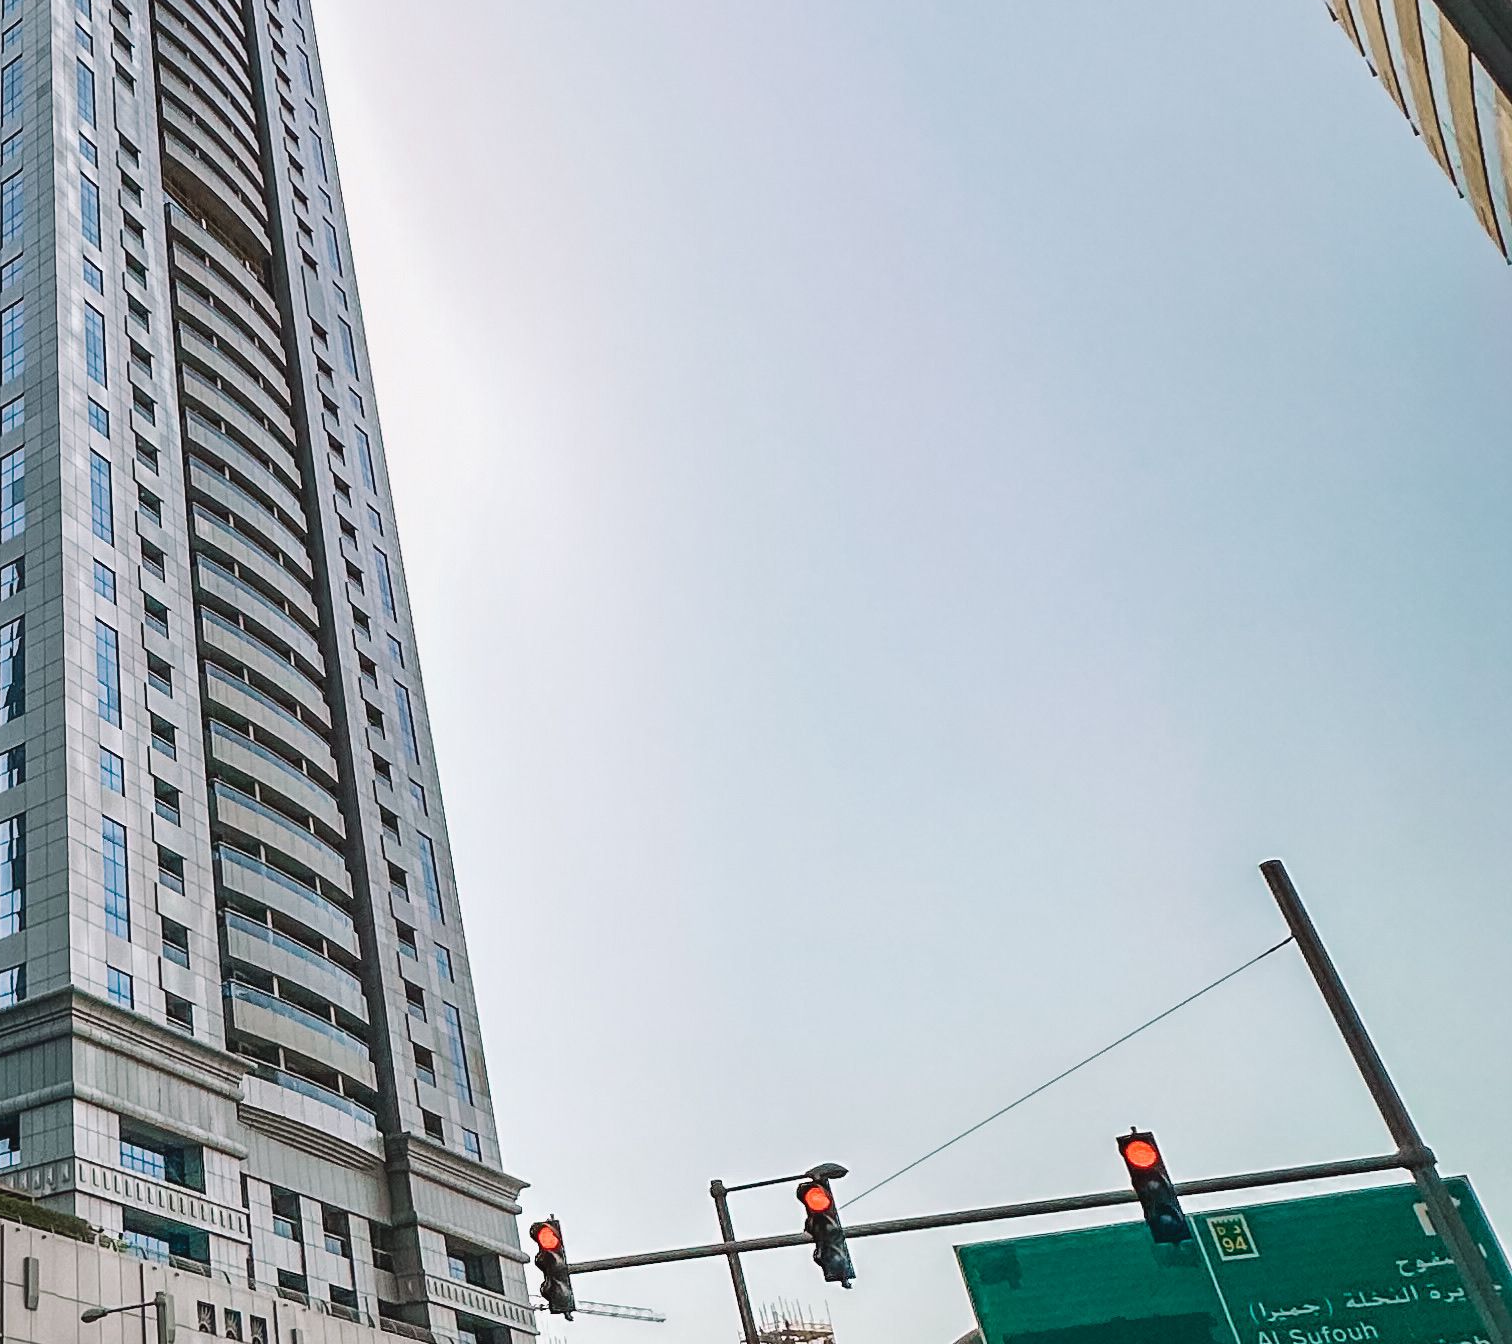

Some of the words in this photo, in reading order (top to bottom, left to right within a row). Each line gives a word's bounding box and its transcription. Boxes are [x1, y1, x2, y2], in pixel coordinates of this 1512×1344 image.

[1222, 1236, 1248, 1253] 94
[1344, 1284, 1419, 1309] النخلة
[1249, 1297, 1334, 1325] (جميرا)
